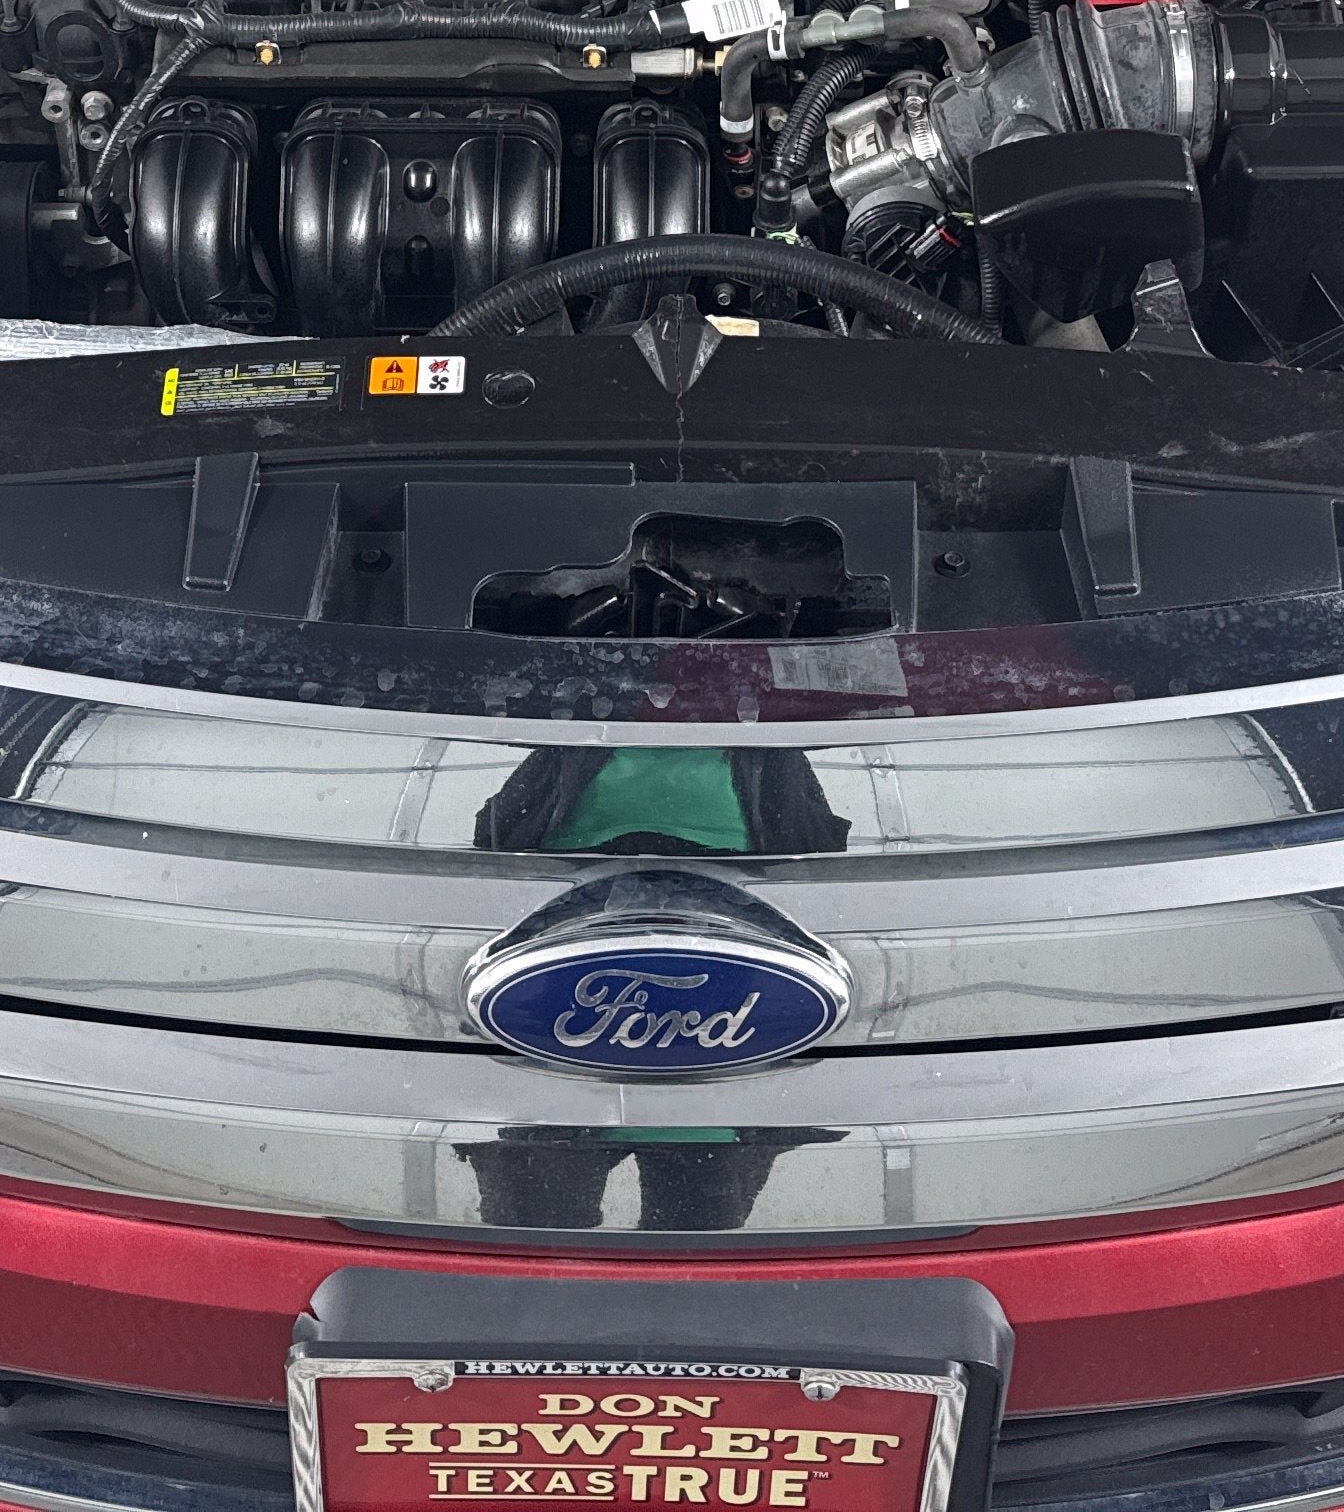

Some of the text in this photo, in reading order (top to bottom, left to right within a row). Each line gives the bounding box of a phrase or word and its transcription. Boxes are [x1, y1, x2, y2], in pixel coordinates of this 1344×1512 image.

[553, 968, 761, 1048] Ford
[464, 1360, 791, 1379] HEWLETTAUTO.COM
[538, 1393, 720, 1419] DON
[354, 1422, 900, 1465] HEWLETT
